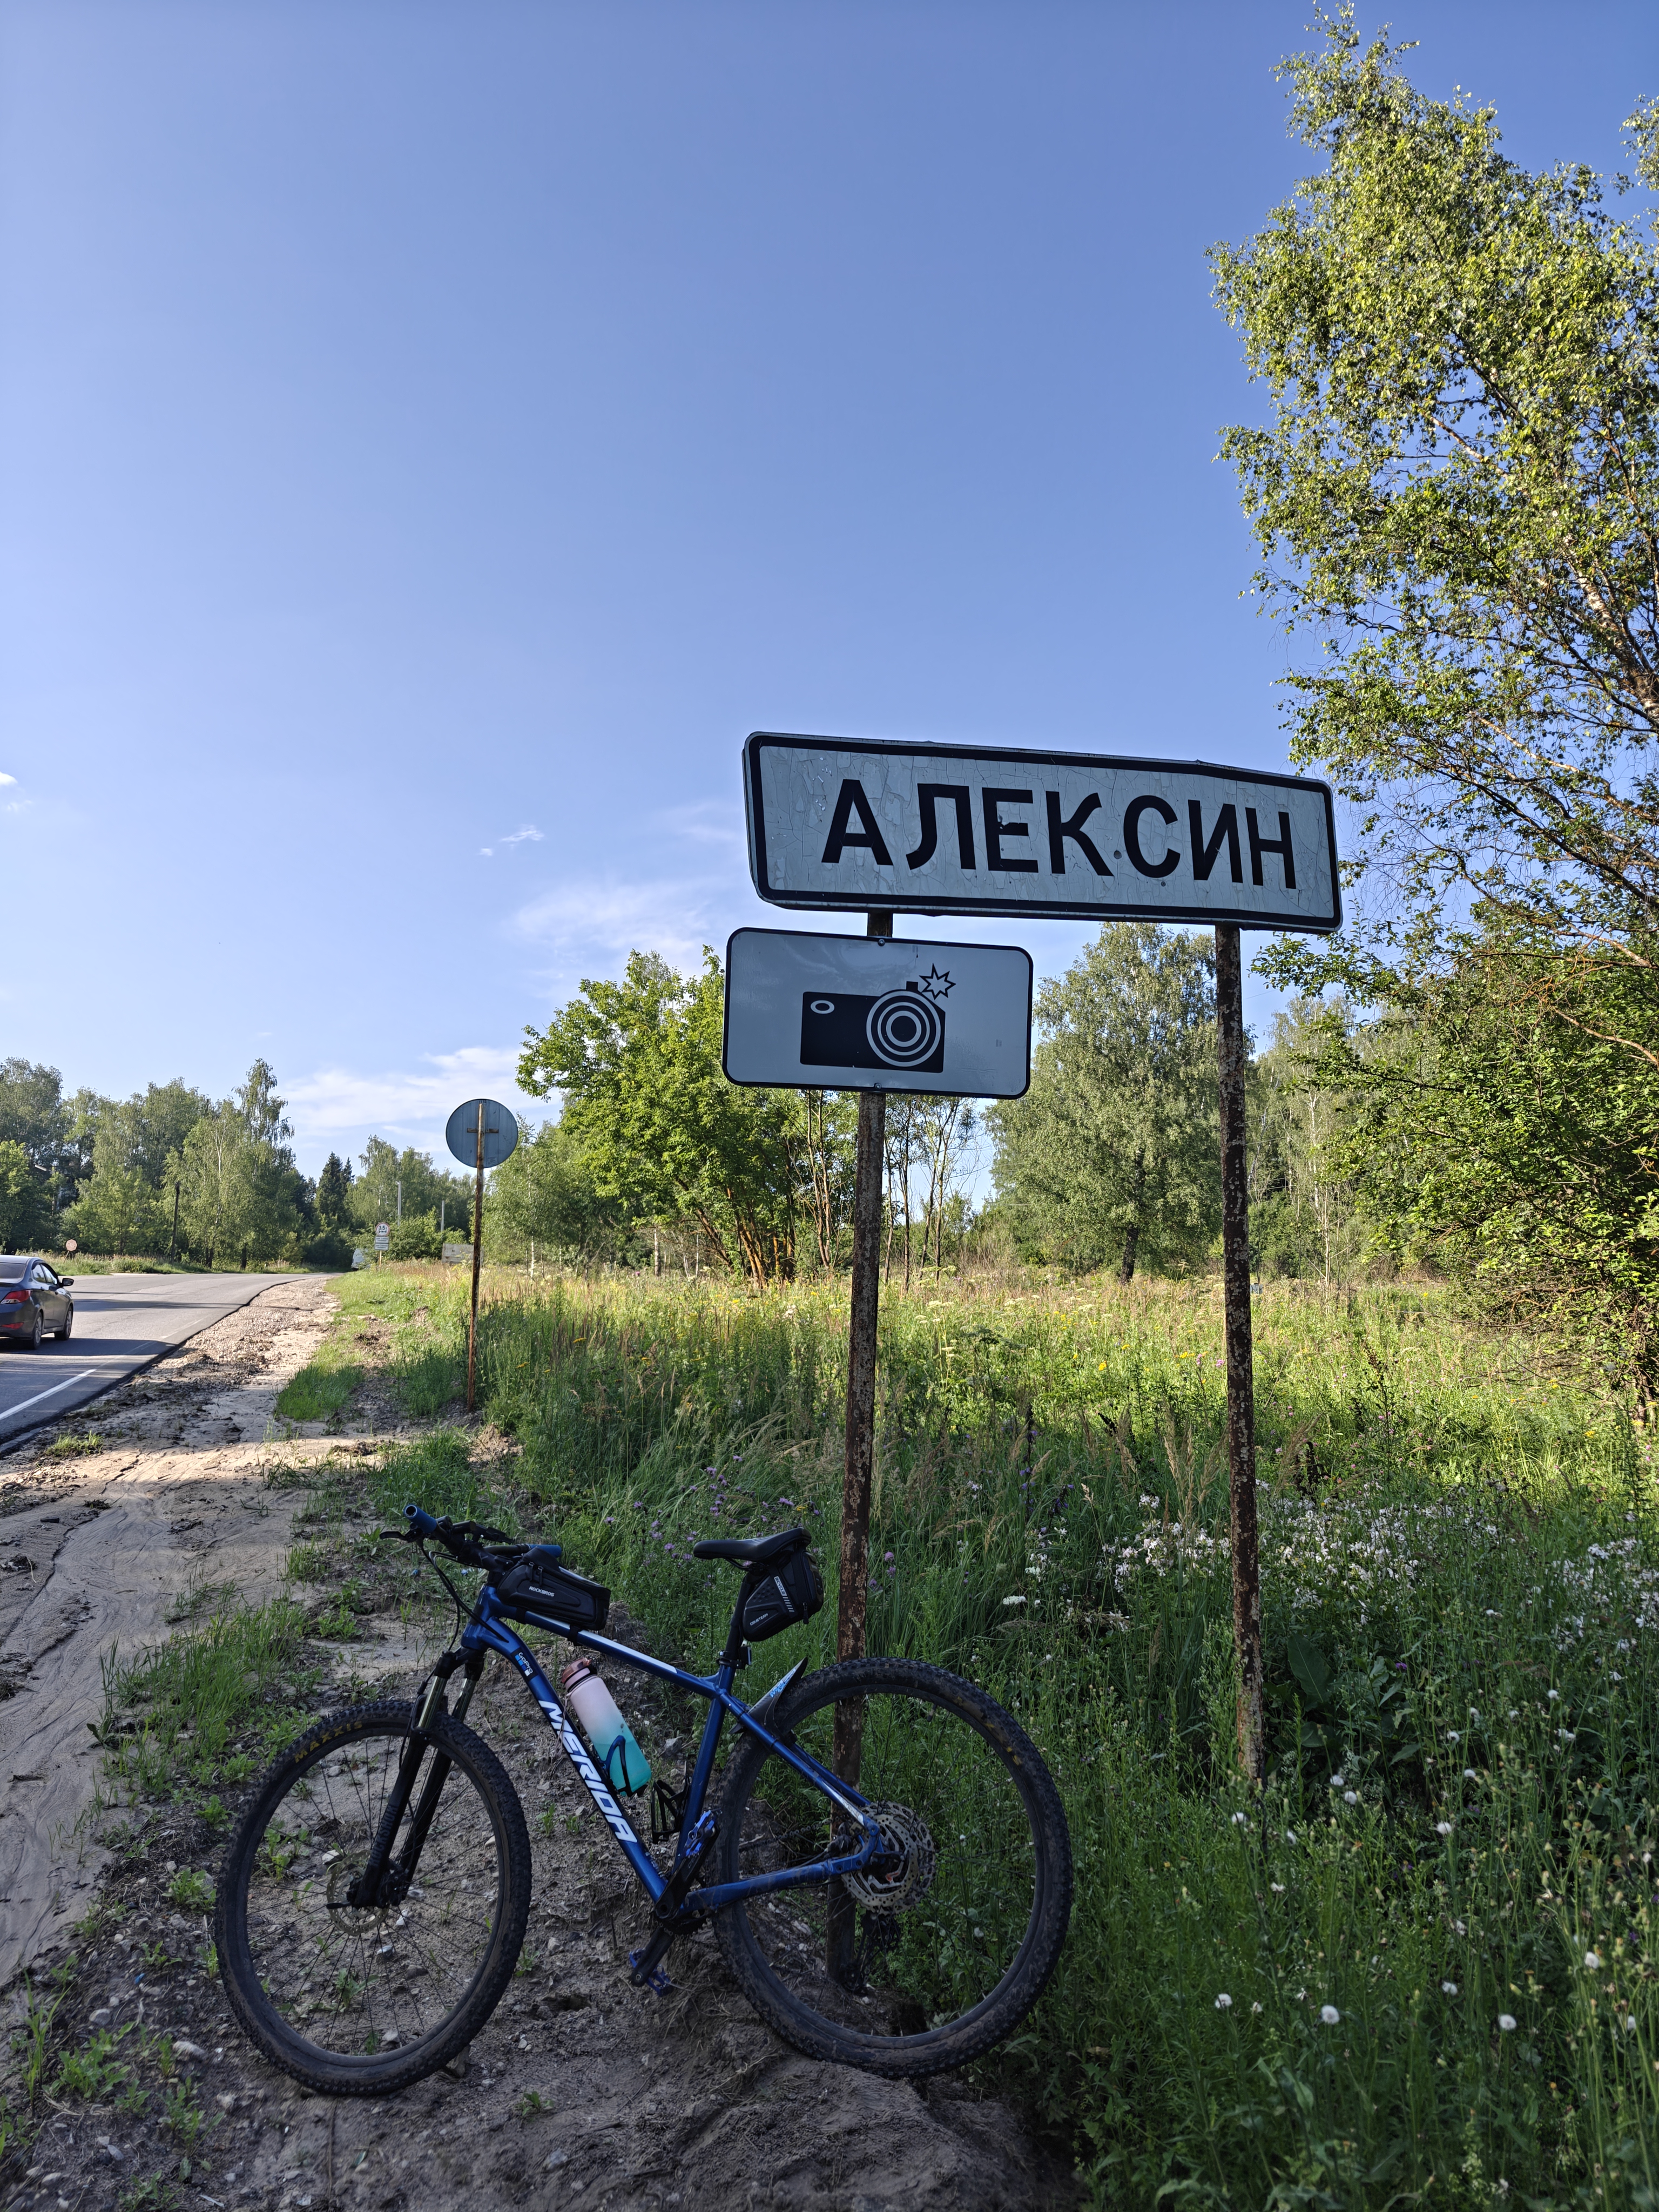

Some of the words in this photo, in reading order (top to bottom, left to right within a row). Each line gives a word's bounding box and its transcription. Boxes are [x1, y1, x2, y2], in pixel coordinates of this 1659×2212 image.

[821, 779, 1297, 889] АЛЕКСИН
[529, 1586, 555, 1597] ROCKBROS
[518, 1652, 533, 1674] GoPro
[294, 1721, 363, 1763] MAXXIS
[538, 1700, 637, 1843] MERIDA
